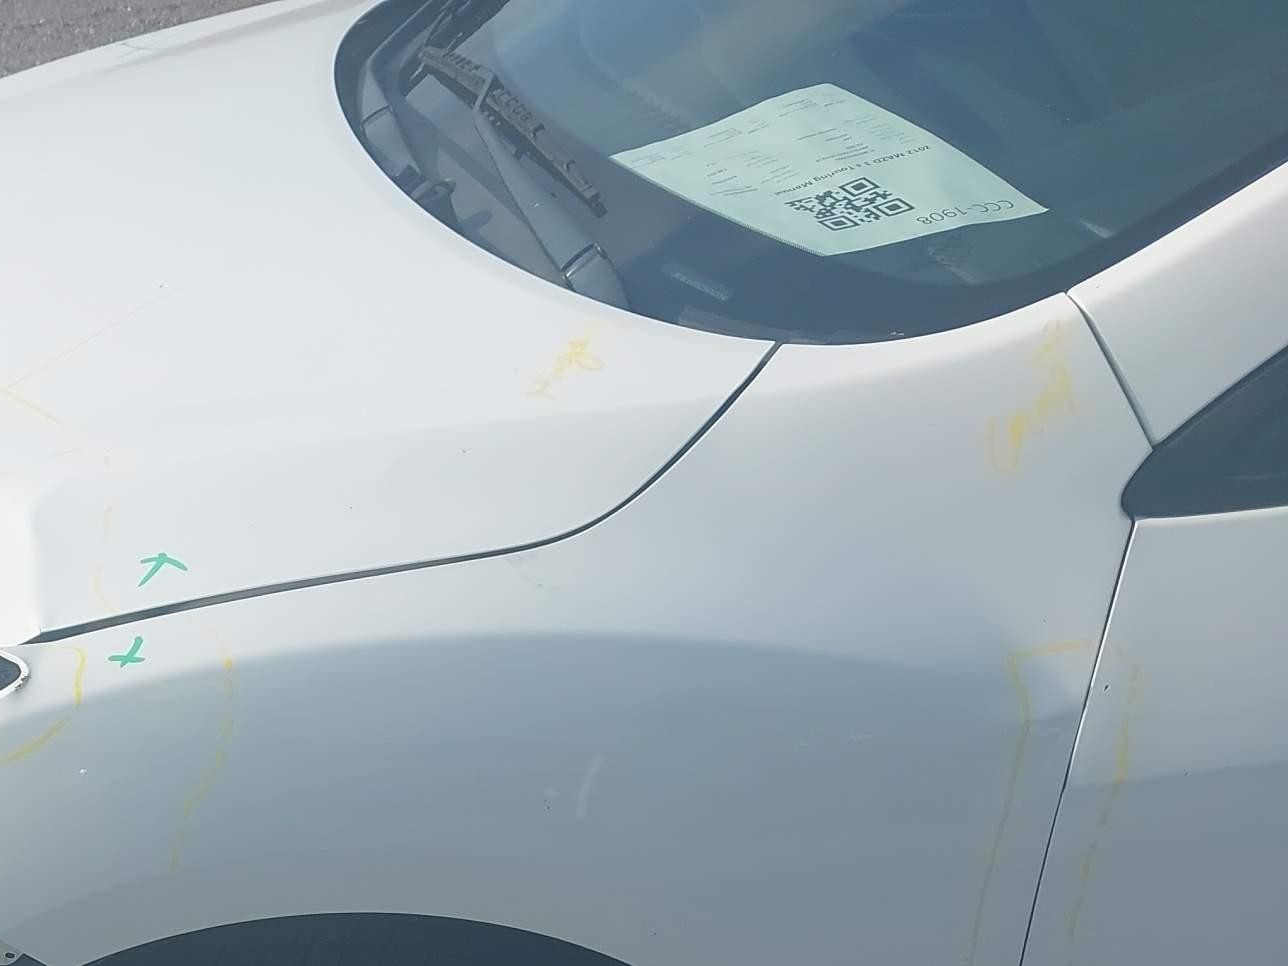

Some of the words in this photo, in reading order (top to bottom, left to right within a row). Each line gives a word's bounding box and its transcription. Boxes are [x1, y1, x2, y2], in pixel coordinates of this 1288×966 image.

[907, 144, 931, 156] 2012
[813, 164, 855, 182] Touring
[916, 200, 1014, 225] CCC-1908
